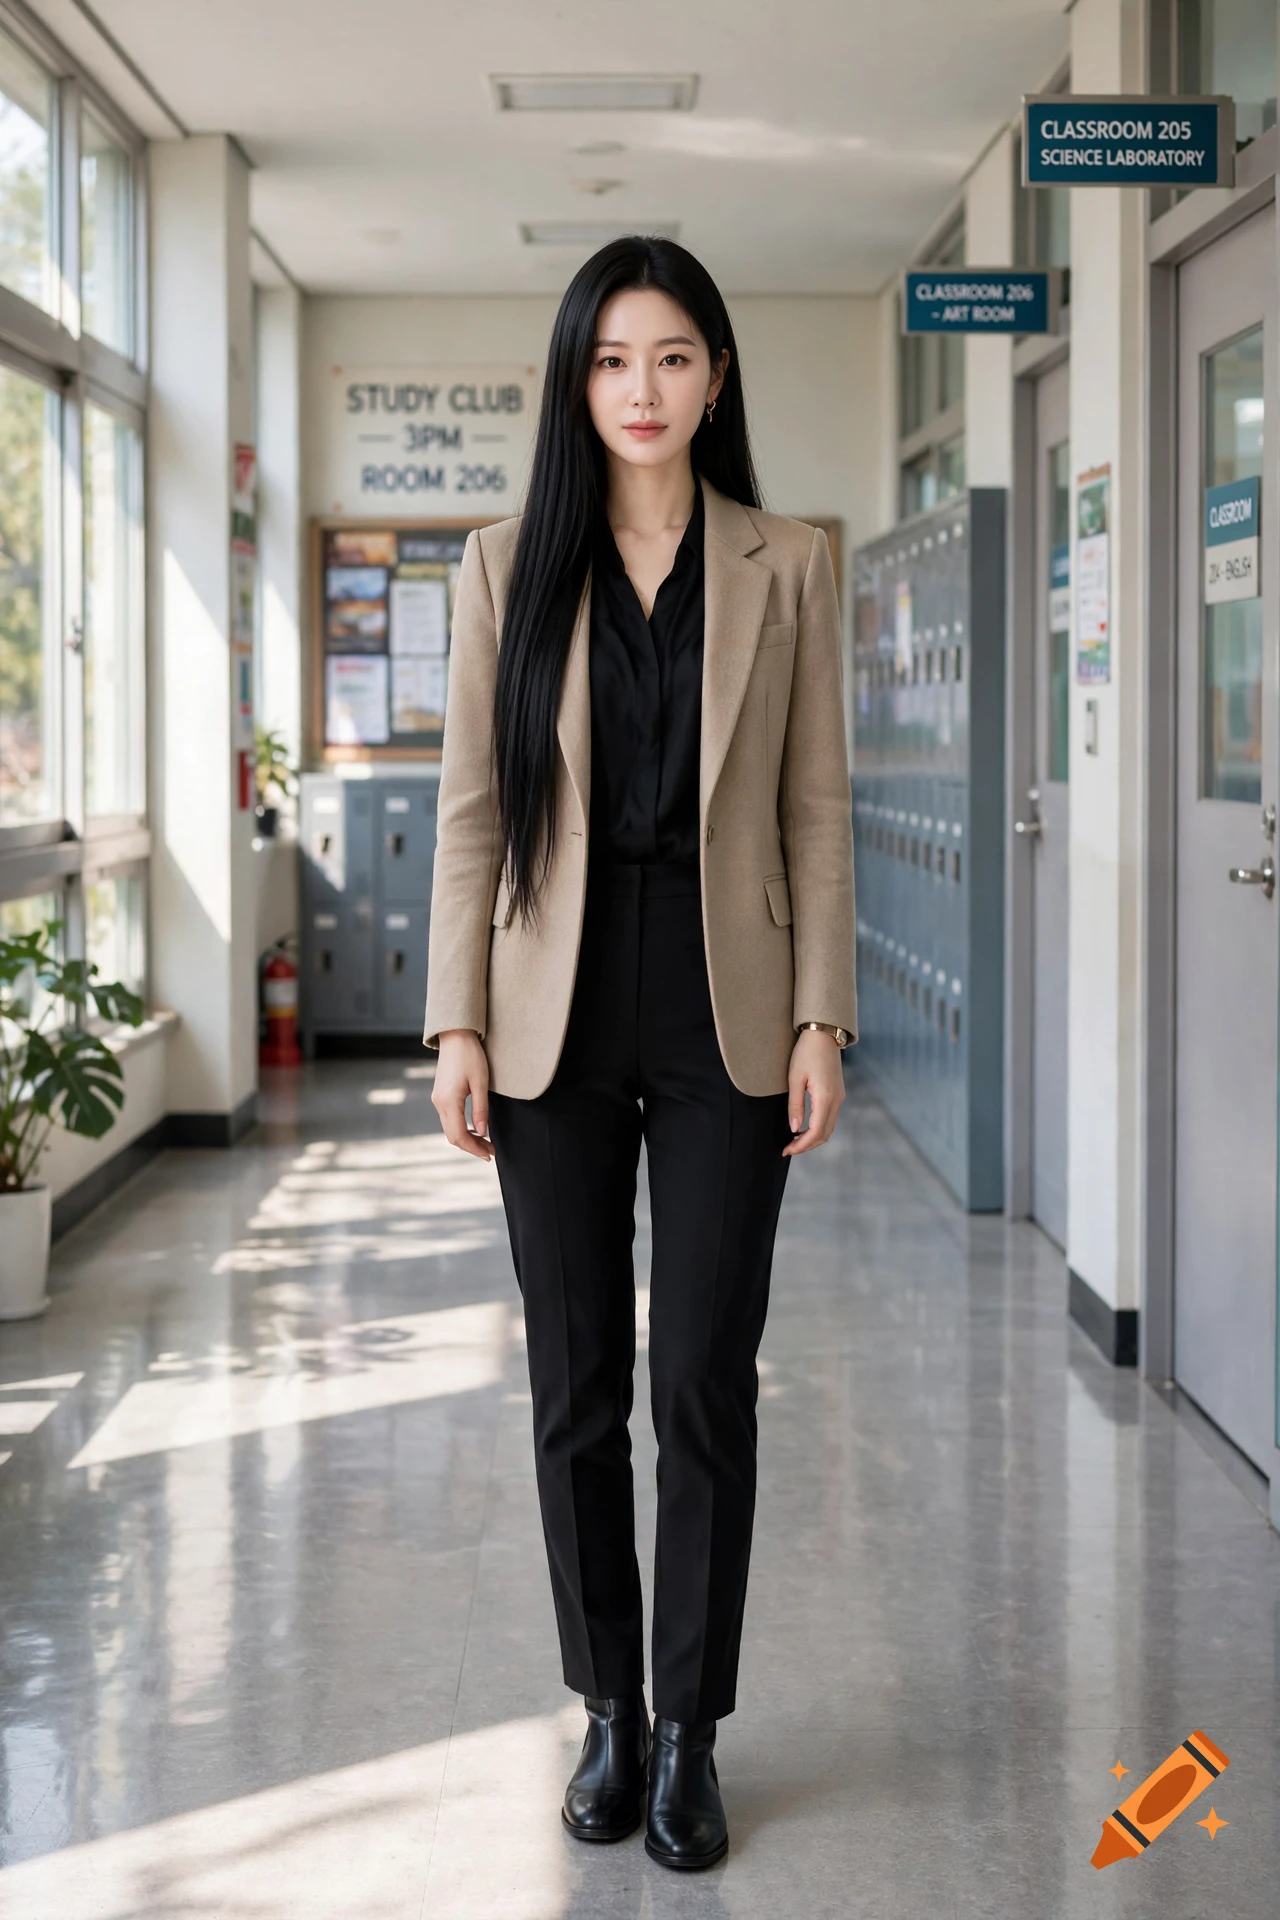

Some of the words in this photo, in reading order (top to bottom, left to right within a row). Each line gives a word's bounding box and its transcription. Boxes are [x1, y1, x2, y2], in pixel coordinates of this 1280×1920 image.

[1040, 120, 1153, 139] CLASSROOM
[1157, 121, 1192, 140] 205
[1040, 149, 1103, 165] SCIENCE
[1106, 150, 1205, 166] LABORATORY
[915, 283, 1004, 301] CLASSROOM
[1006, 284, 1034, 301] 206
[942, 305, 970, 322] ART
[972, 305, 1015, 322] ROOM
[346, 383, 439, 414] STUDY
[448, 383, 524, 414] CLUB
[402, 424, 463, 452] 3PM
[361, 464, 445, 494] ROOM
[455, 464, 507, 494] 206
[1209, 497, 1252, 528] CLASSROOM
